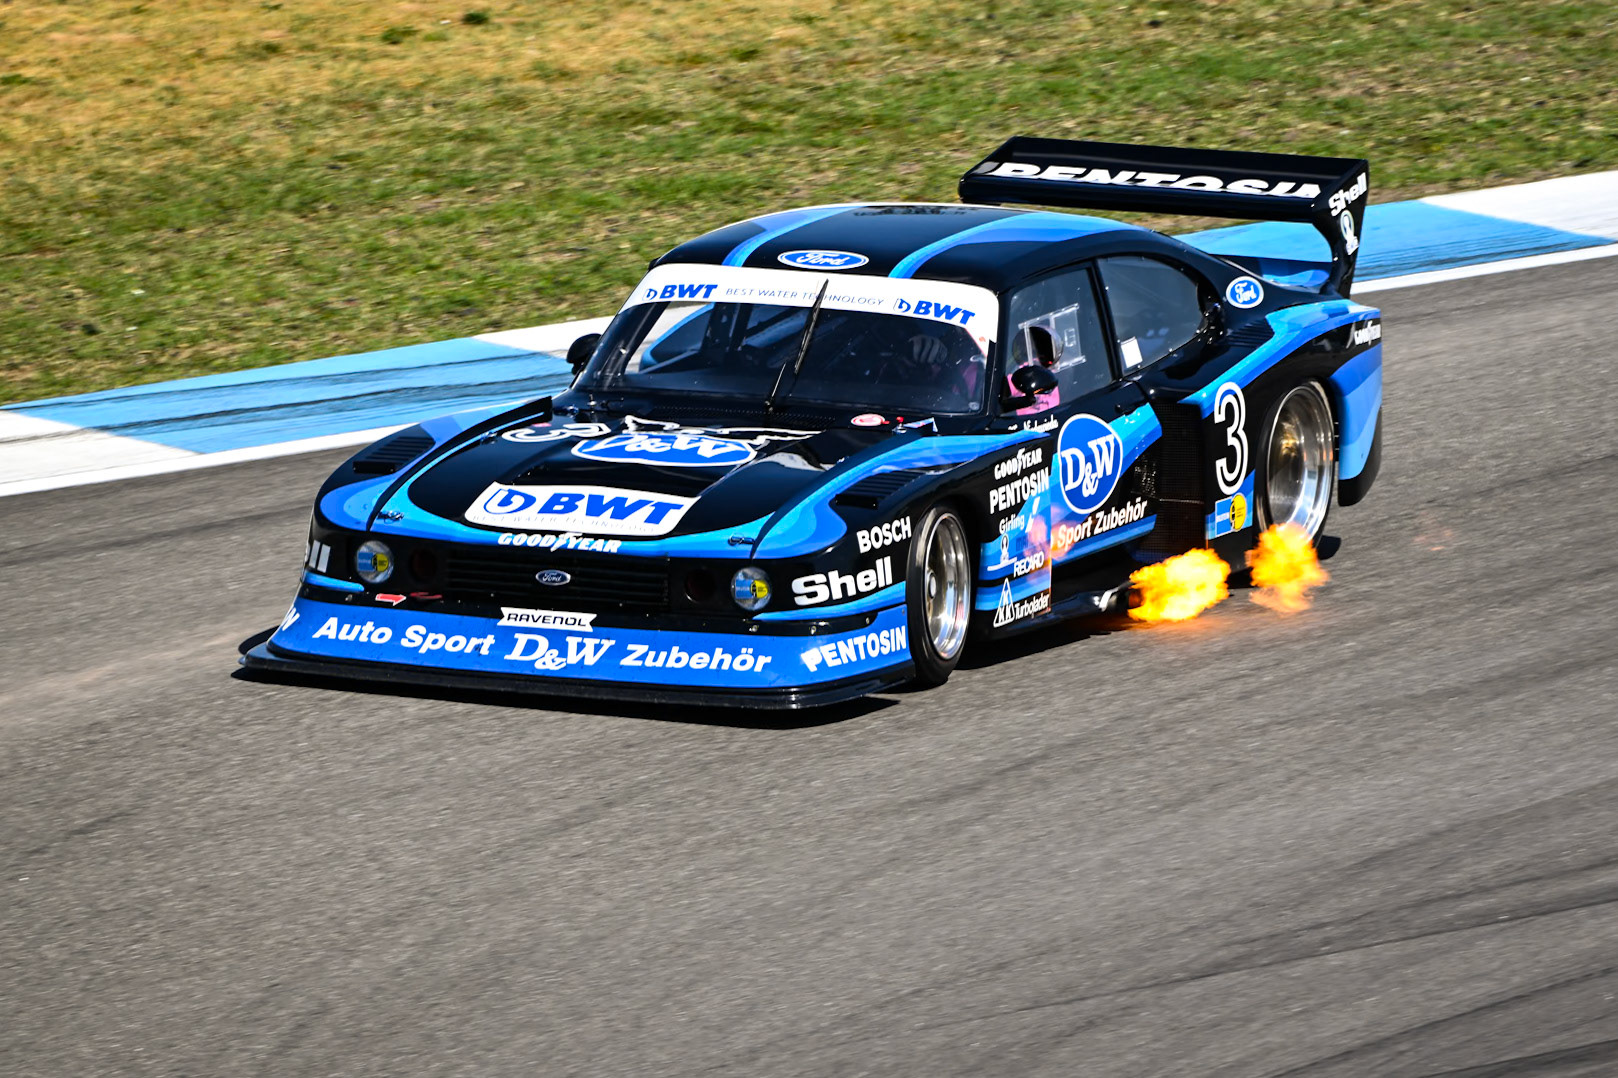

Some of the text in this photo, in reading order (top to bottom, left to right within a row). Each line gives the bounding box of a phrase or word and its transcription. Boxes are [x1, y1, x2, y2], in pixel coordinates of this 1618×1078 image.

[1328, 172, 1368, 217] Shell
[796, 252, 851, 266] Ford
[659, 284, 718, 299] BWT
[725, 288, 885, 306] BEST WATER TEHNOLOGY
[1234, 282, 1257, 303] Ford
[913, 299, 976, 325] BWT
[582, 434, 747, 458] D&W
[1213, 381, 1249, 495] 3
[994, 447, 1042, 480] GOODYEAR
[1061, 435, 1115, 497] D&W
[990, 466, 1050, 514] PENTOSIN
[537, 492, 685, 526] BWT
[1057, 519, 1092, 548] Sport
[1094, 497, 1148, 534] Zubehör
[856, 516, 912, 554] BOSCH
[999, 513, 1025, 534] Girling
[497, 532, 622, 552] GOODYEAR
[542, 572, 562, 582] Ford
[1014, 550, 1045, 577] RECARO
[791, 556, 893, 606] Shell
[1014, 593, 1050, 619] Turbolader
[507, 613, 587, 627] RAVENOL
[312, 616, 393, 644] Auto
[400, 624, 496, 656] Sport
[503, 632, 616, 671] D&W
[620, 643, 773, 673] Zubehör
[801, 625, 908, 673] PENTOSIN
